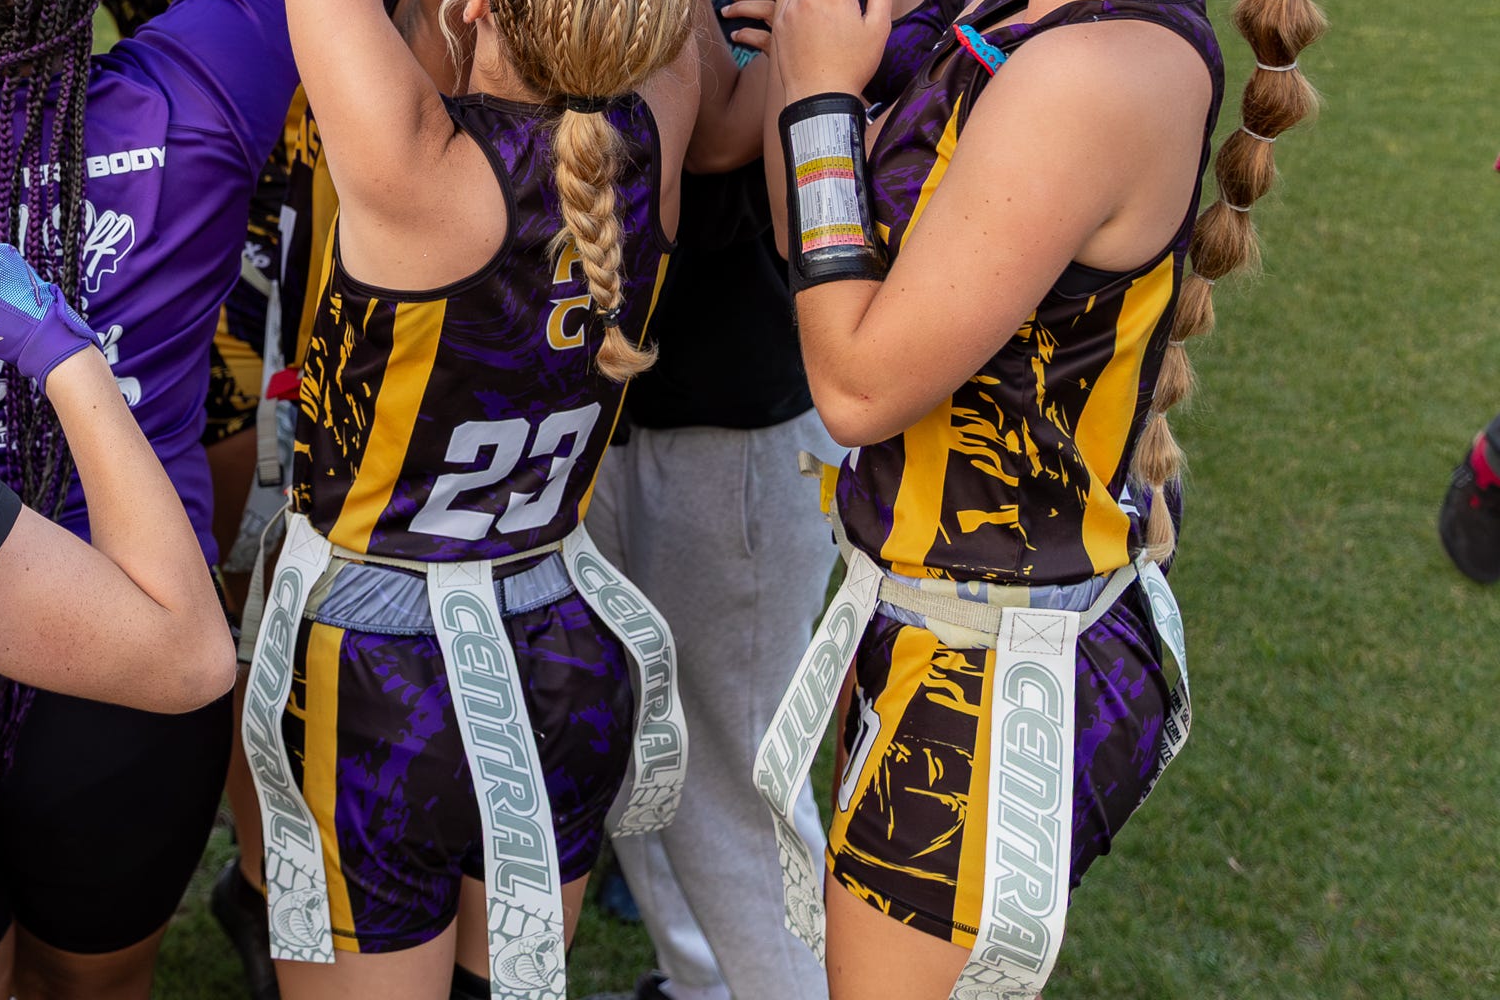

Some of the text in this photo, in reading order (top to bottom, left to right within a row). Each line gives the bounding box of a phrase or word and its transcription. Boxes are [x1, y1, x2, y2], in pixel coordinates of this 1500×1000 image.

[86, 146, 166, 178] BODY
[408, 402, 601, 541] 23
[440, 589, 553, 898] CENTRAL
[980, 660, 1064, 975] CENTRAL
